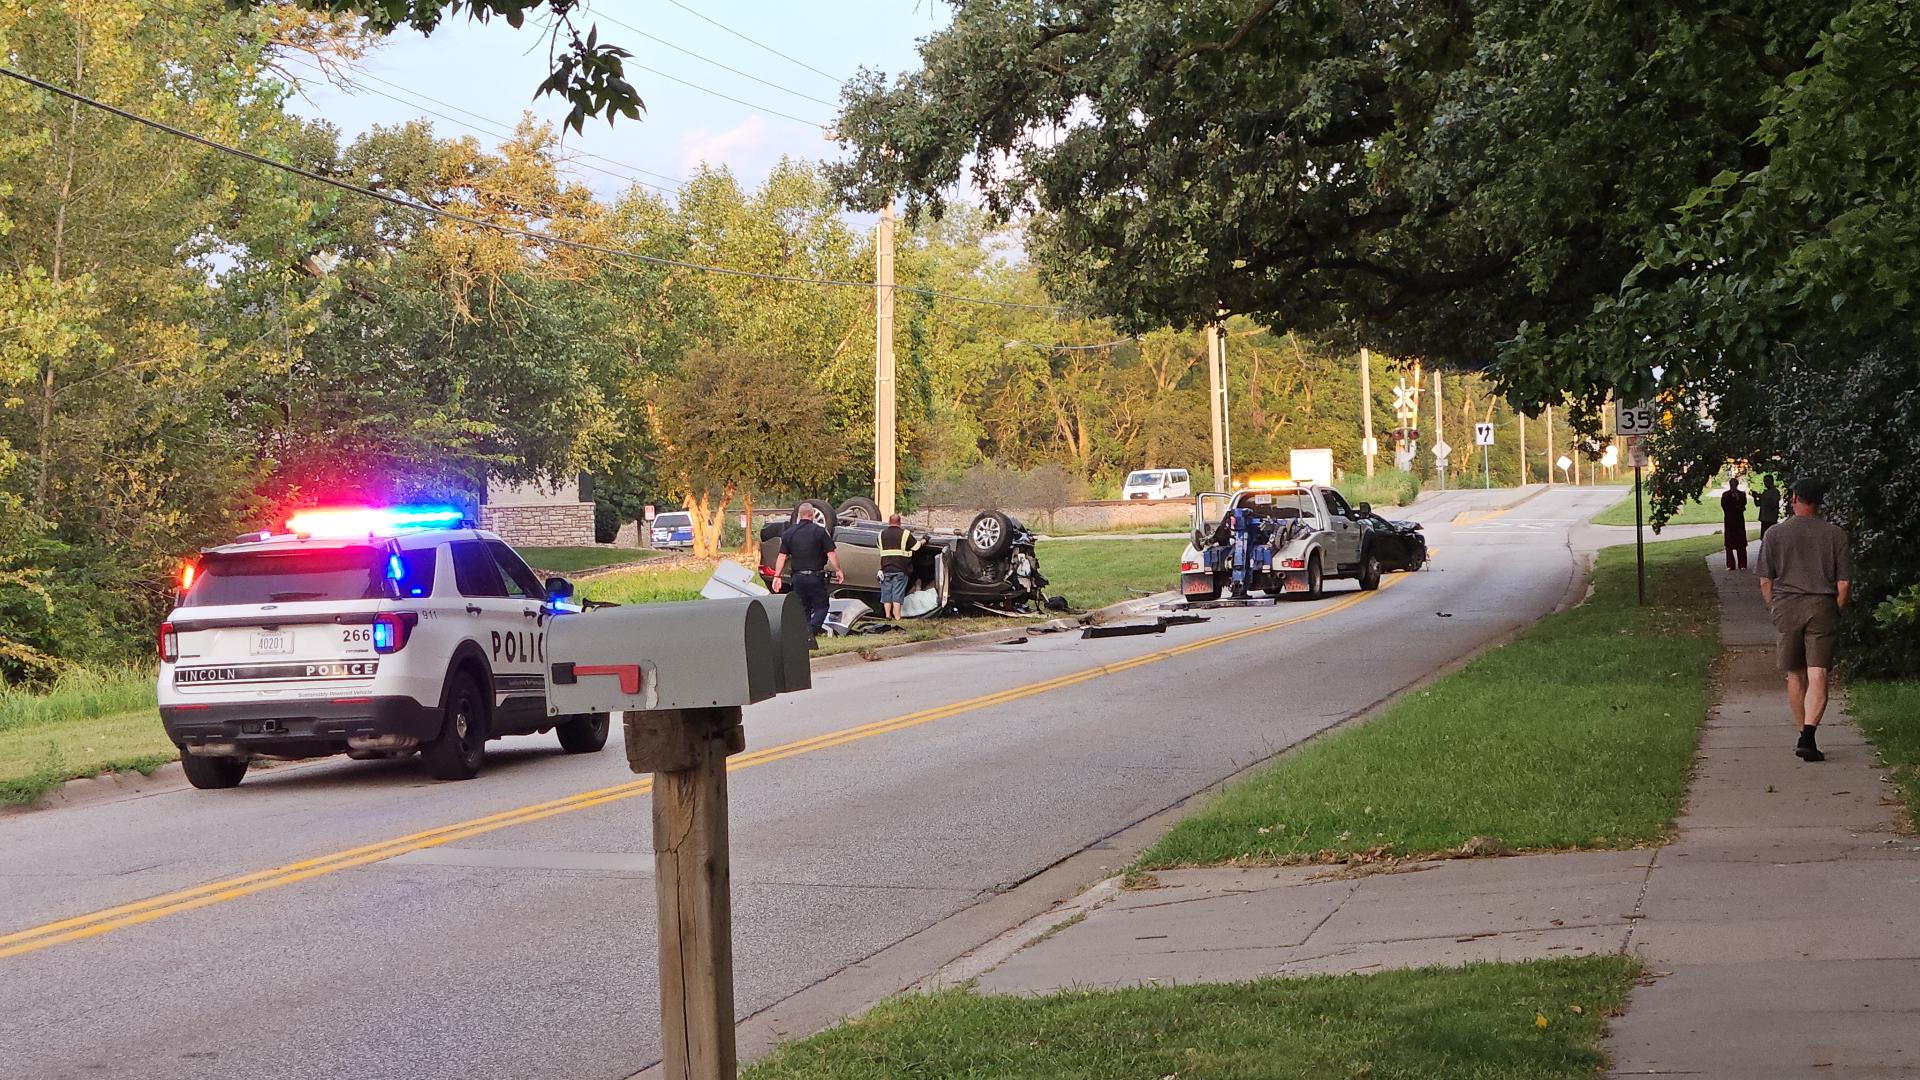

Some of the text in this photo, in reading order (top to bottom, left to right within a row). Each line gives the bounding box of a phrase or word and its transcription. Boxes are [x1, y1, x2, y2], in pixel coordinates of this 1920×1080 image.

[1621, 411, 1652, 430] 35
[422, 609, 438, 620] 911
[343, 629, 370, 642] 266
[258, 637, 283, 650] 40201
[178, 669, 235, 682] LINCOLN
[306, 663, 373, 676] POLICE
